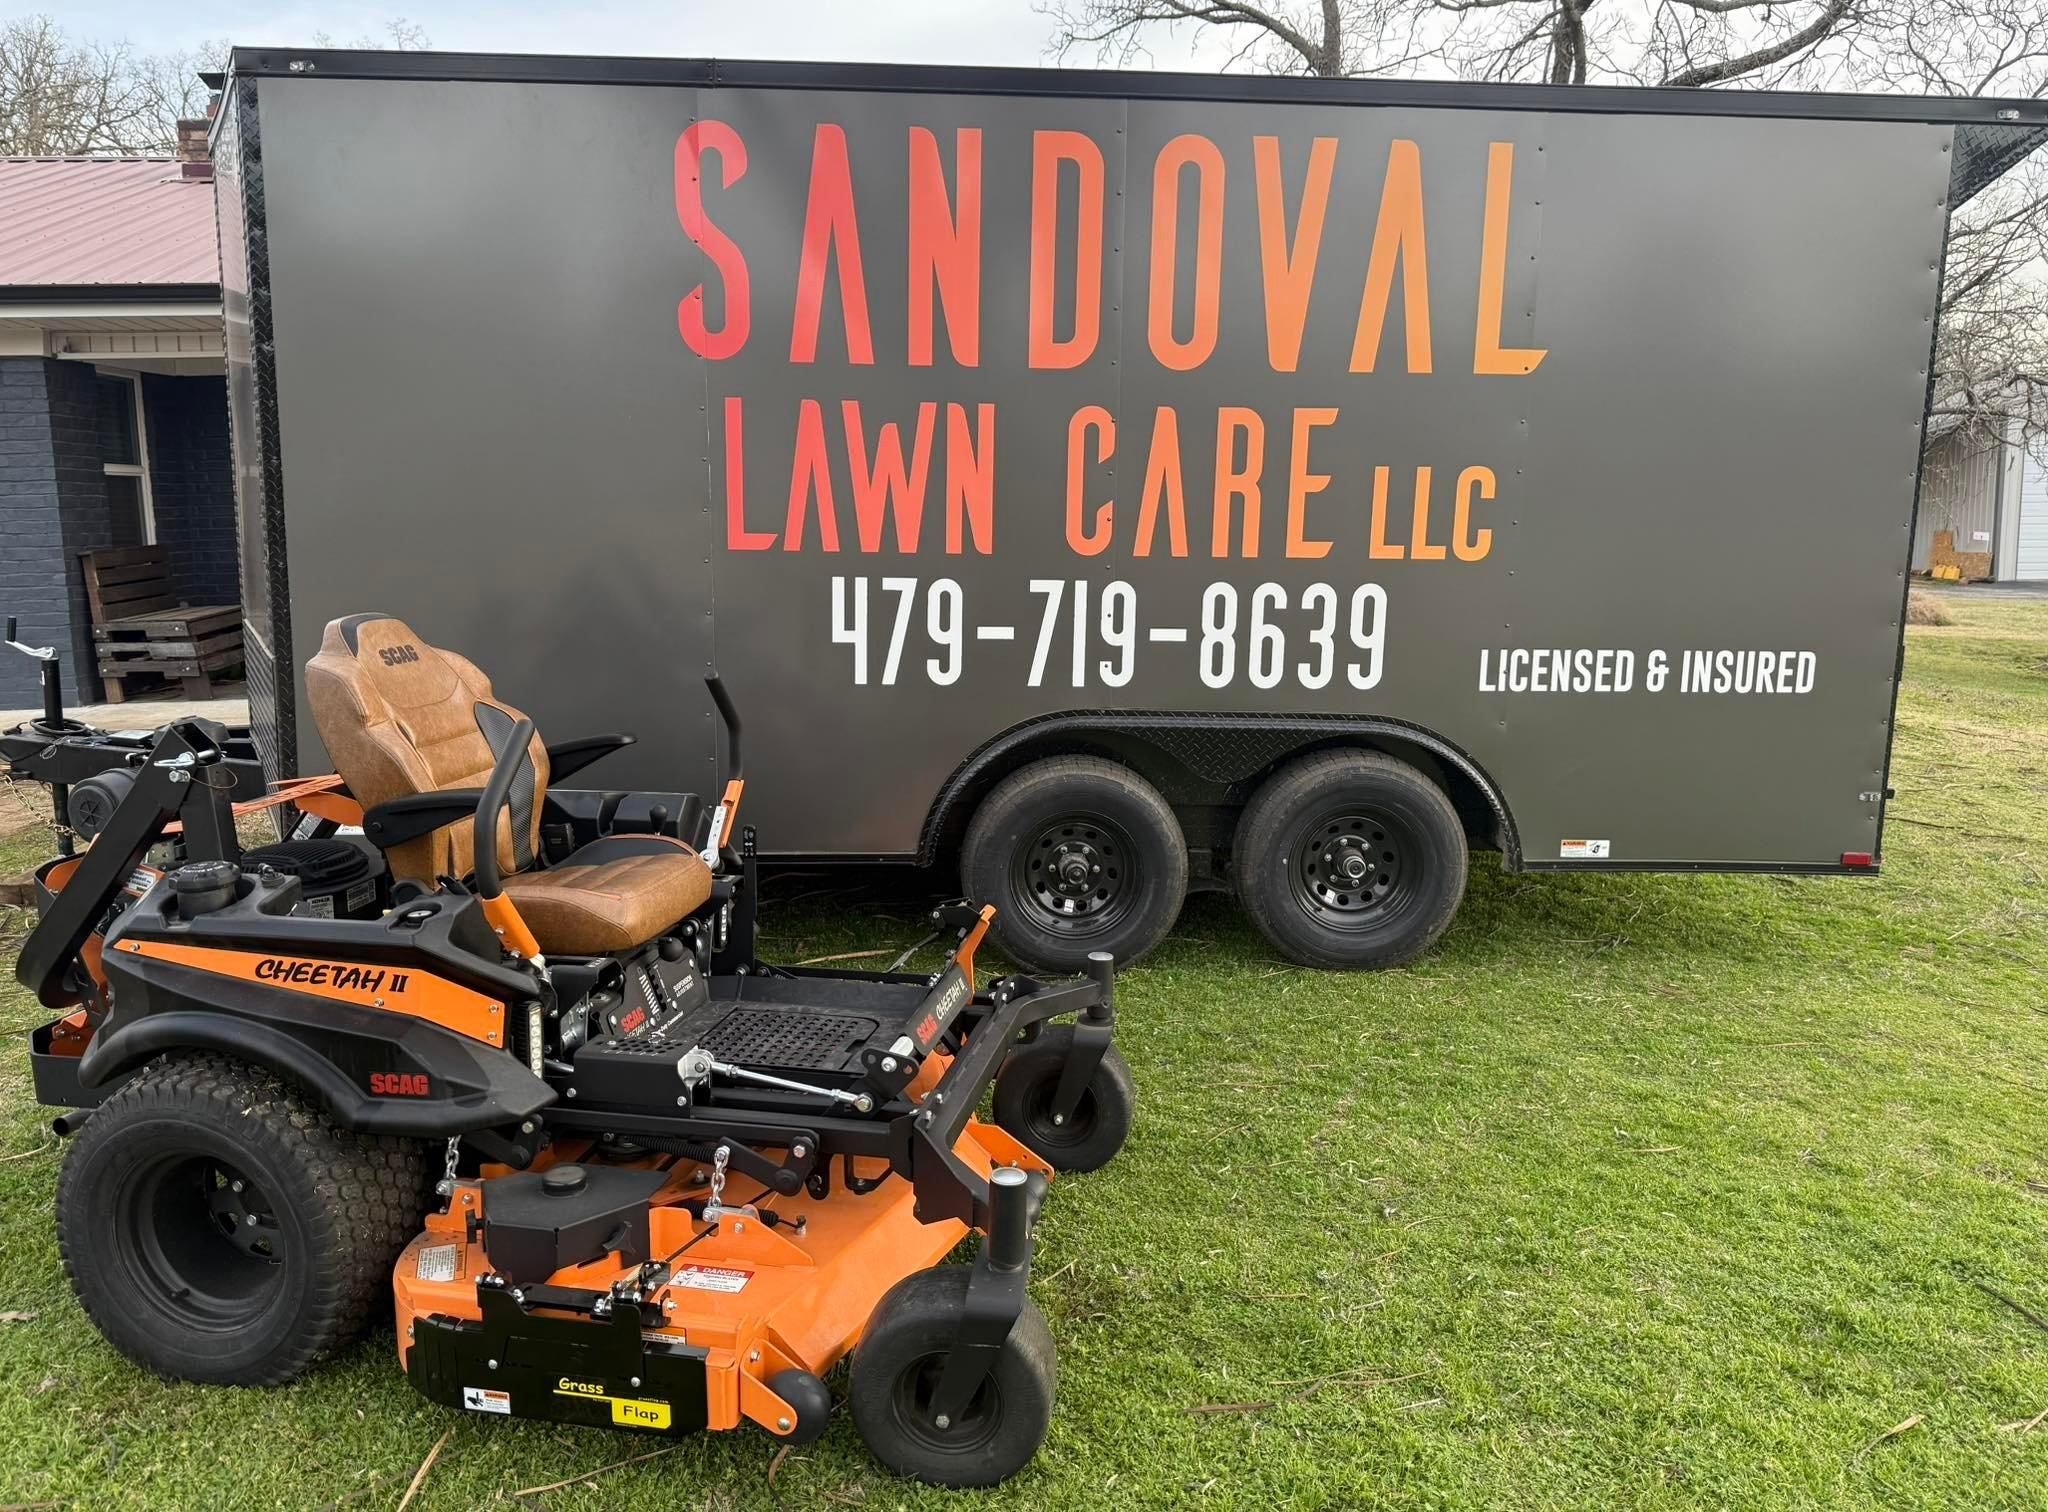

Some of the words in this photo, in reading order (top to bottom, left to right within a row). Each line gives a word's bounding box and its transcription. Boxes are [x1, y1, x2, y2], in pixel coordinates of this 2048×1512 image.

[675, 119, 1548, 376] SANDOVAL
[723, 397, 996, 556] LAWN
[1065, 405, 1340, 560] CARE
[1369, 465, 1497, 562] LLC
[831, 576, 1388, 690] 479-719-8639
[379, 644, 419, 667] SCAG
[1478, 648, 1635, 693] LICENSED
[1646, 649, 1670, 693] &
[1680, 650, 1817, 694] INSURED
[255, 959, 386, 993] CHEETAH
[388, 973, 409, 993] II
[621, 1006, 647, 1033] SCAG
[916, 1012, 938, 1046] SCAG
[935, 981, 964, 1020] CHEETAH
[370, 1073, 429, 1096] SCAG
[702, 1266, 747, 1278] DANGER
[558, 1376, 605, 1395] Grass
[622, 1404, 659, 1423] Flap
